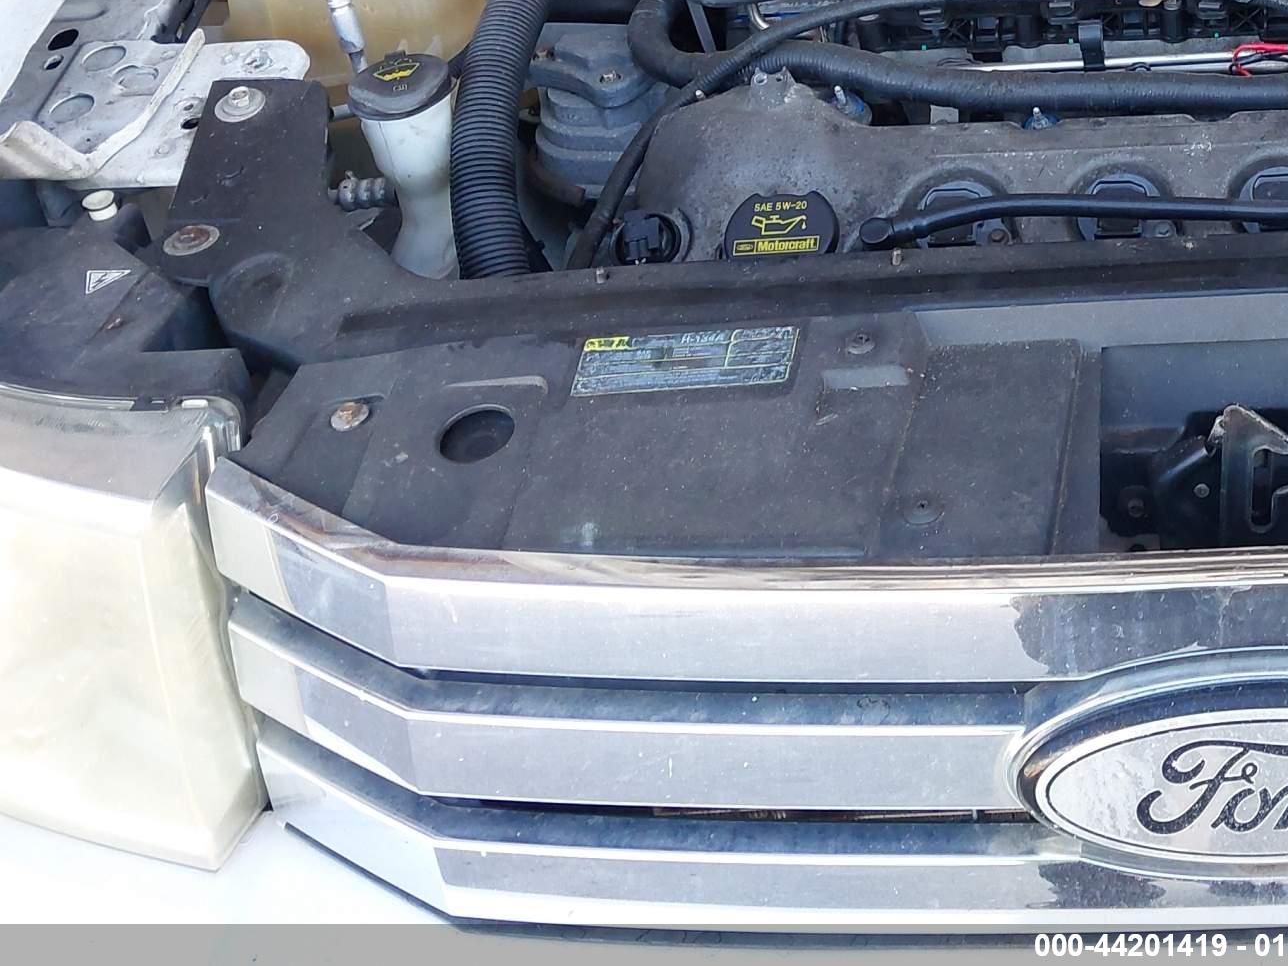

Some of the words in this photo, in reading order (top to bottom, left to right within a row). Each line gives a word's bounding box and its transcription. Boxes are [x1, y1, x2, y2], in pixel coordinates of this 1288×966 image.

[754, 202, 773, 212] SAE
[775, 200, 808, 210] 5W-20
[757, 237, 816, 251] Motorcraft
